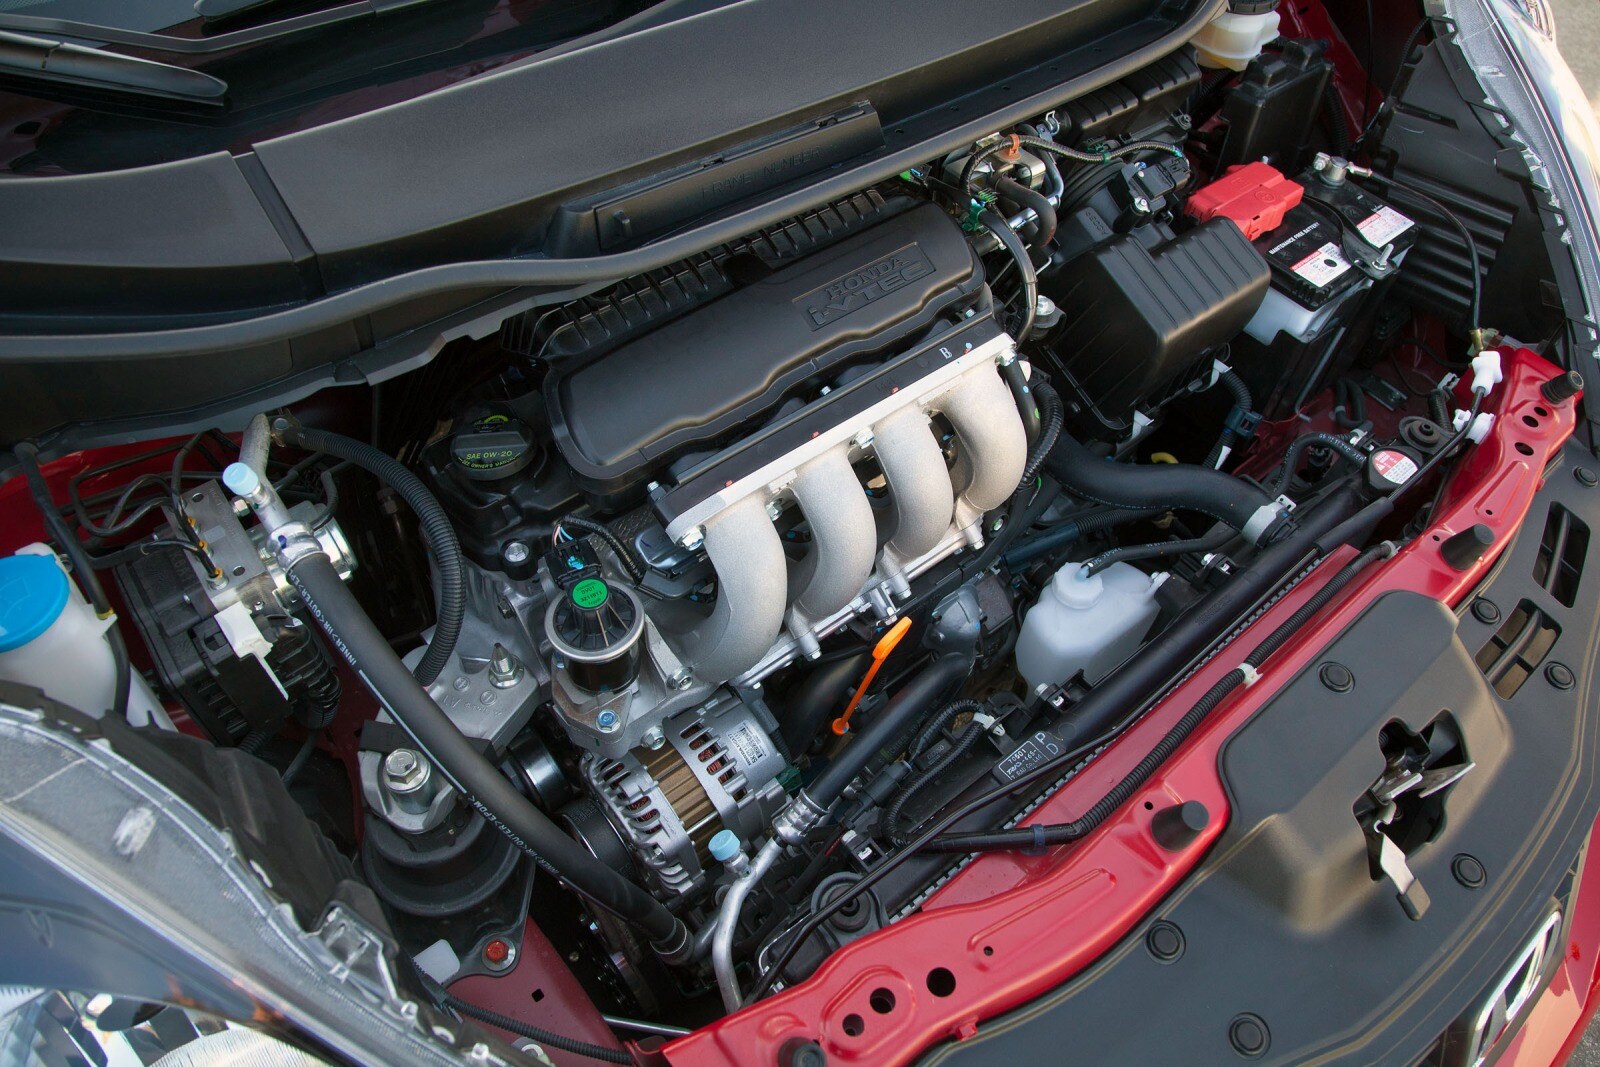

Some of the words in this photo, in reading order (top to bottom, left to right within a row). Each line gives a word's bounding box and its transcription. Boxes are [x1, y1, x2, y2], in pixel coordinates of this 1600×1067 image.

[1269, 237, 1295, 254] MAINTENANCE
[1294, 230, 1305, 240] FREE
[1303, 222, 1320, 234] BATTERY
[824, 257, 910, 300] HONDA
[807, 260, 927, 326] i-VTEC
[939, 347, 953, 360] B
[1035, 732, 1046, 745] P
[1046, 743, 1059, 755] D
